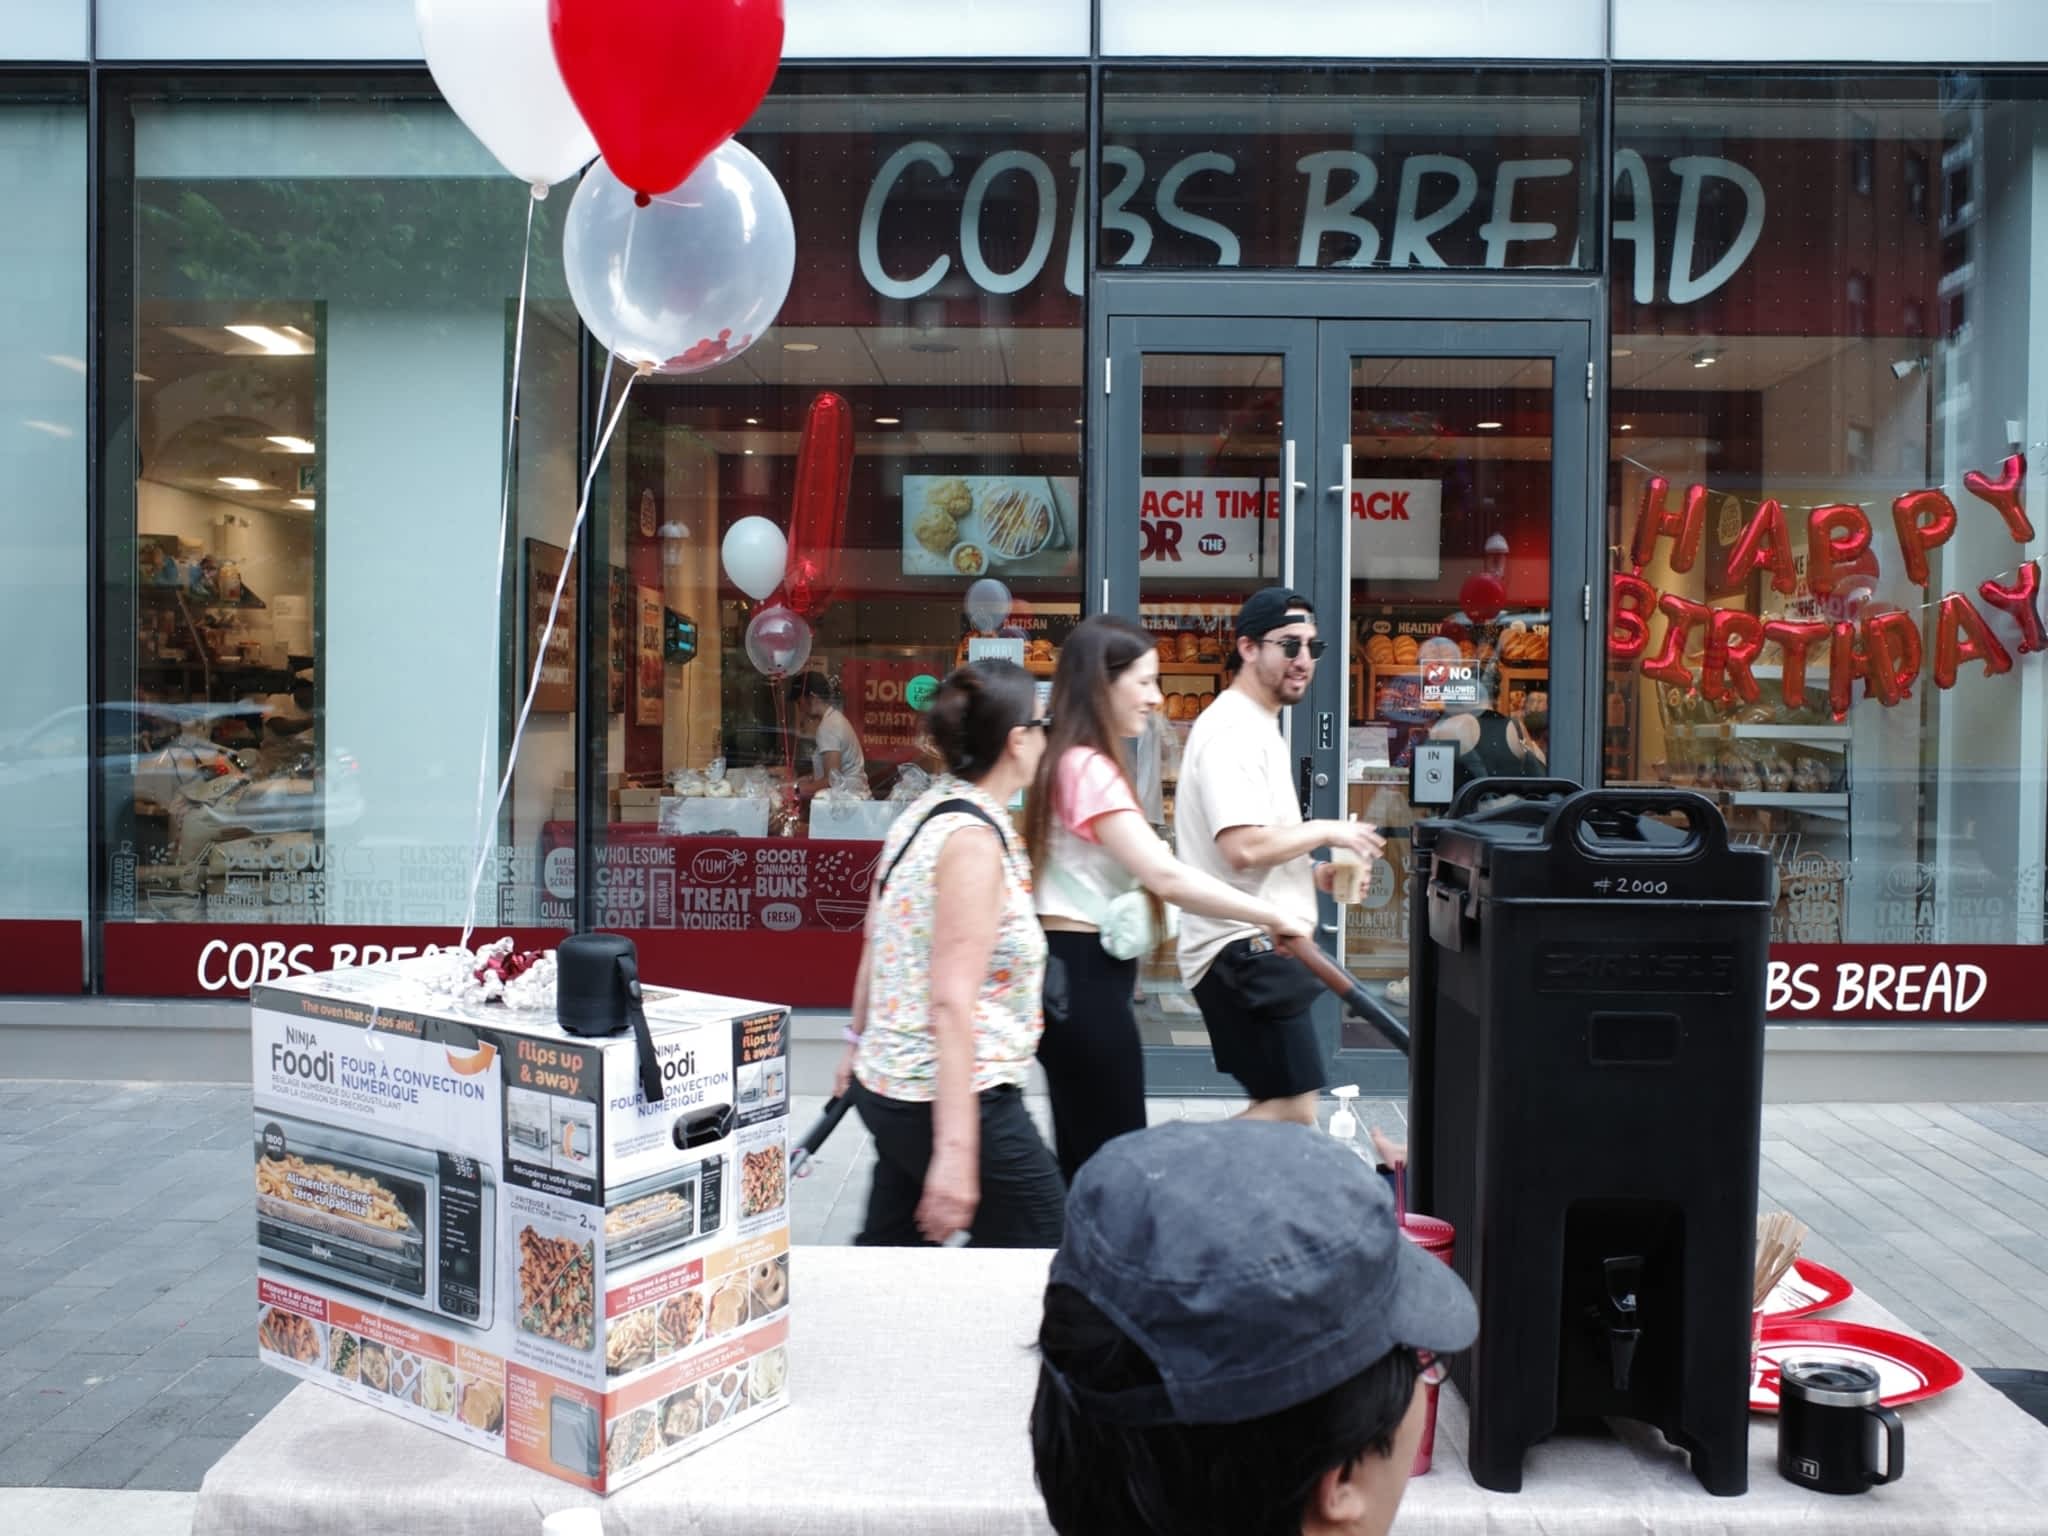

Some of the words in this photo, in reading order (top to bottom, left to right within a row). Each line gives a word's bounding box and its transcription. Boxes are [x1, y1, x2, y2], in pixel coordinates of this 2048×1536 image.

[857, 141, 1240, 300] COBS
[1295, 148, 1767, 306] BREAD
[1141, 490, 1202, 518] ACH
[1216, 490, 1280, 519] TIME
[1351, 491, 1411, 521] ACK
[1631, 453, 2036, 593] HAPPY
[1140, 520, 1183, 562] OR
[1200, 538, 1225, 551] THE
[1003, 618, 1048, 631] ARTISAN
[1398, 622, 1443, 635] HEALTHY
[1608, 560, 2048, 722] BIRTHDAY
[1449, 667, 1472, 680] NO
[865, 679, 905, 702] JOI
[1424, 685, 1441, 695] PETS
[1443, 685, 1476, 695] ALLOWED
[1321, 712, 1330, 749] PULL
[1428, 751, 1440, 761] IN
[595, 847, 676, 865] WHOLESOME
[756, 848, 808, 863] GOOEY
[596, 867, 644, 886] CAPE
[755, 863, 808, 875] CINNAMON
[756, 876, 808, 898] BUNS
[1591, 874, 1669, 895] #2000
[1789, 881, 1839, 901] CAPE
[596, 887, 645, 909] SEED
[656, 880, 671, 919] ARTISAN
[681, 887, 752, 912] TREAT
[541, 901, 573, 918] QUAL
[596, 909, 645, 929] LOAF
[681, 911, 751, 930] YOURSELF
[767, 911, 796, 923] FRESH
[1789, 901, 1839, 923] SEED
[1874, 900, 1946, 926] TREAT
[197, 938, 315, 991] COBS
[1766, 961, 1821, 1012] BS
[1832, 961, 1988, 1013] BREAD
[302, 999, 318, 1014] The
[320, 1003, 343, 1018] oven
[344, 1006, 364, 1022] that
[286, 1025, 317, 1050] NINJA
[743, 1034, 766, 1049] flips
[272, 1043, 334, 1084] Foodi
[517, 1039, 557, 1067] flips
[560, 1052, 583, 1074] up
[664, 1050, 695, 1081] odi
[743, 1050, 751, 1062] &
[341, 1056, 376, 1078] FOUR
[380, 1060, 389, 1080] À
[393, 1067, 485, 1101] CONVECTION
[520, 1063, 532, 1083] &
[610, 1094, 643, 1112] FOUR
[664, 1072, 729, 1098] ONVECTION
[287, 1172, 328, 1193] Aliments
[329, 1183, 350, 1198] frits
[351, 1191, 373, 1205] avec
